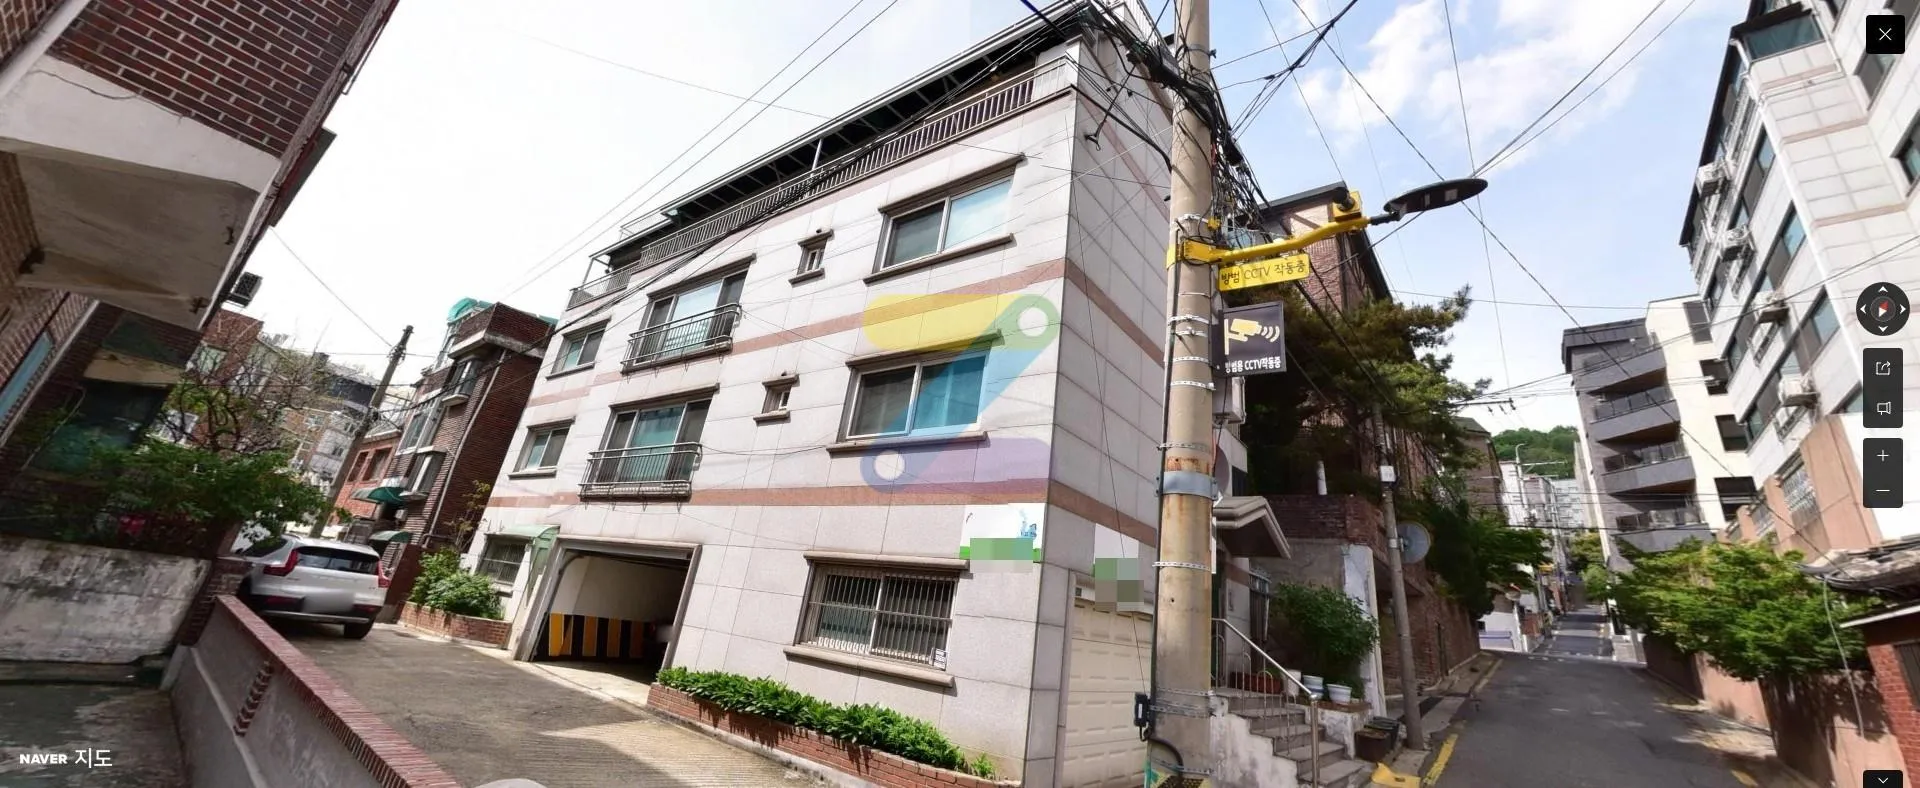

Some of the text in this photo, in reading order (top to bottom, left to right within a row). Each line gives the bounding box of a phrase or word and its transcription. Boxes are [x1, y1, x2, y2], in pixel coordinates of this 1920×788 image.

[1221, 260, 1306, 285] 방범 CCTV 작동중
